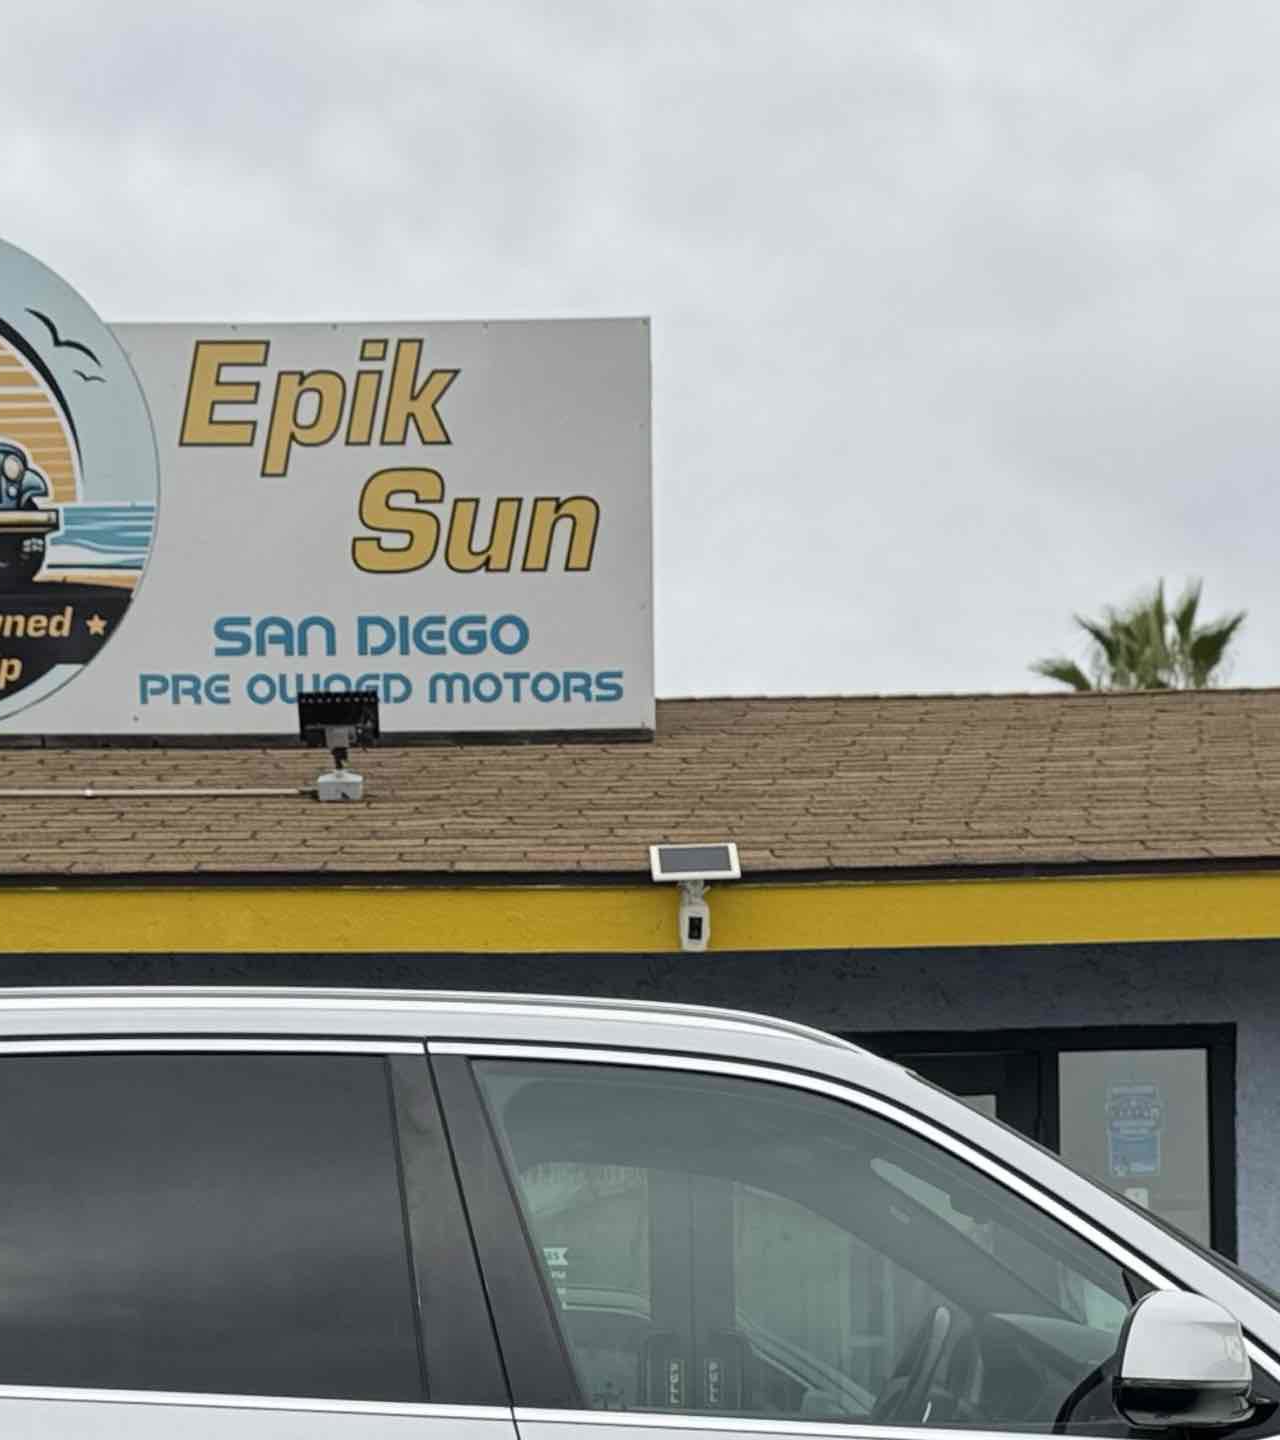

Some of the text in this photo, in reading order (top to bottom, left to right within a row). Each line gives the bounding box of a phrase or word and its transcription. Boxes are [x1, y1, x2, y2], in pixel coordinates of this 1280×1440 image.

[178, 337, 461, 477] Epik
[351, 467, 600, 574] Sun
[214, 614, 529, 656] SAN DIEGO
[139, 673, 231, 704] PRE
[429, 671, 624, 703] MOTORS
